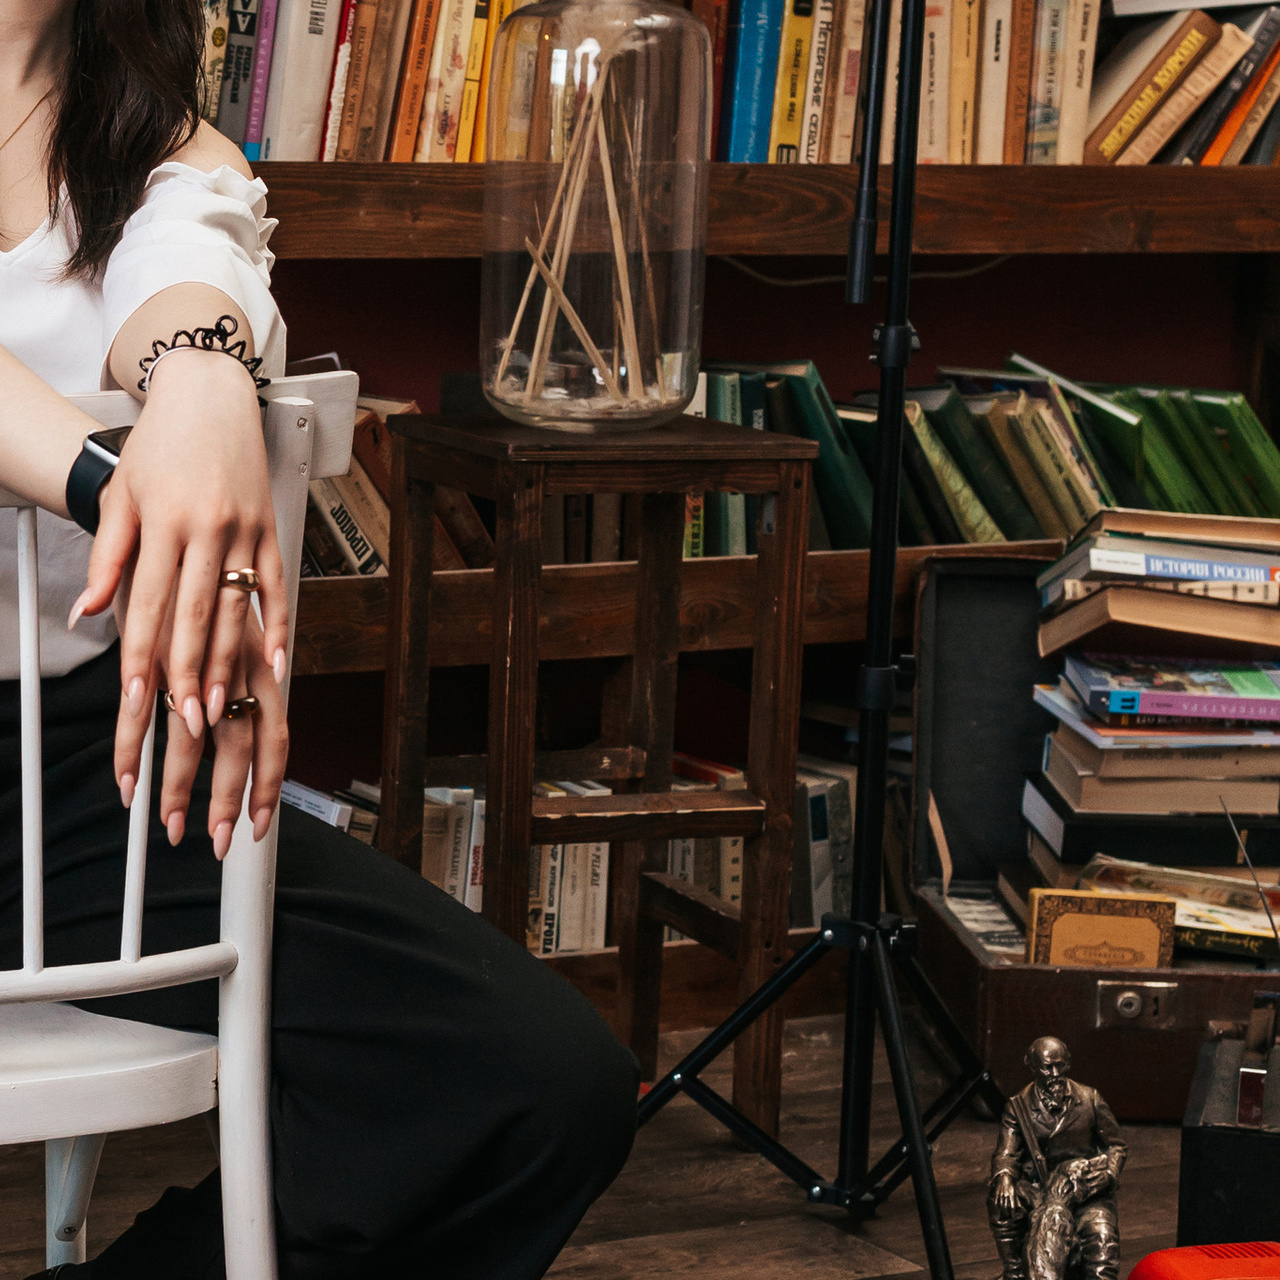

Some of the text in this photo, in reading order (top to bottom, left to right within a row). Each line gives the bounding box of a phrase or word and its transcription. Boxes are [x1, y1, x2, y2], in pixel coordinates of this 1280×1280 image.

[308, 10, 326, 35] ЮРИЙ
[344, 25, 368, 126] ЛАВКА ДРЕВНОСТЕЙ
[329, 501, 370, 562] ПРОЛОГ
[1151, 555, 1264, 584] ИСТОРИЯ РОССИИ
